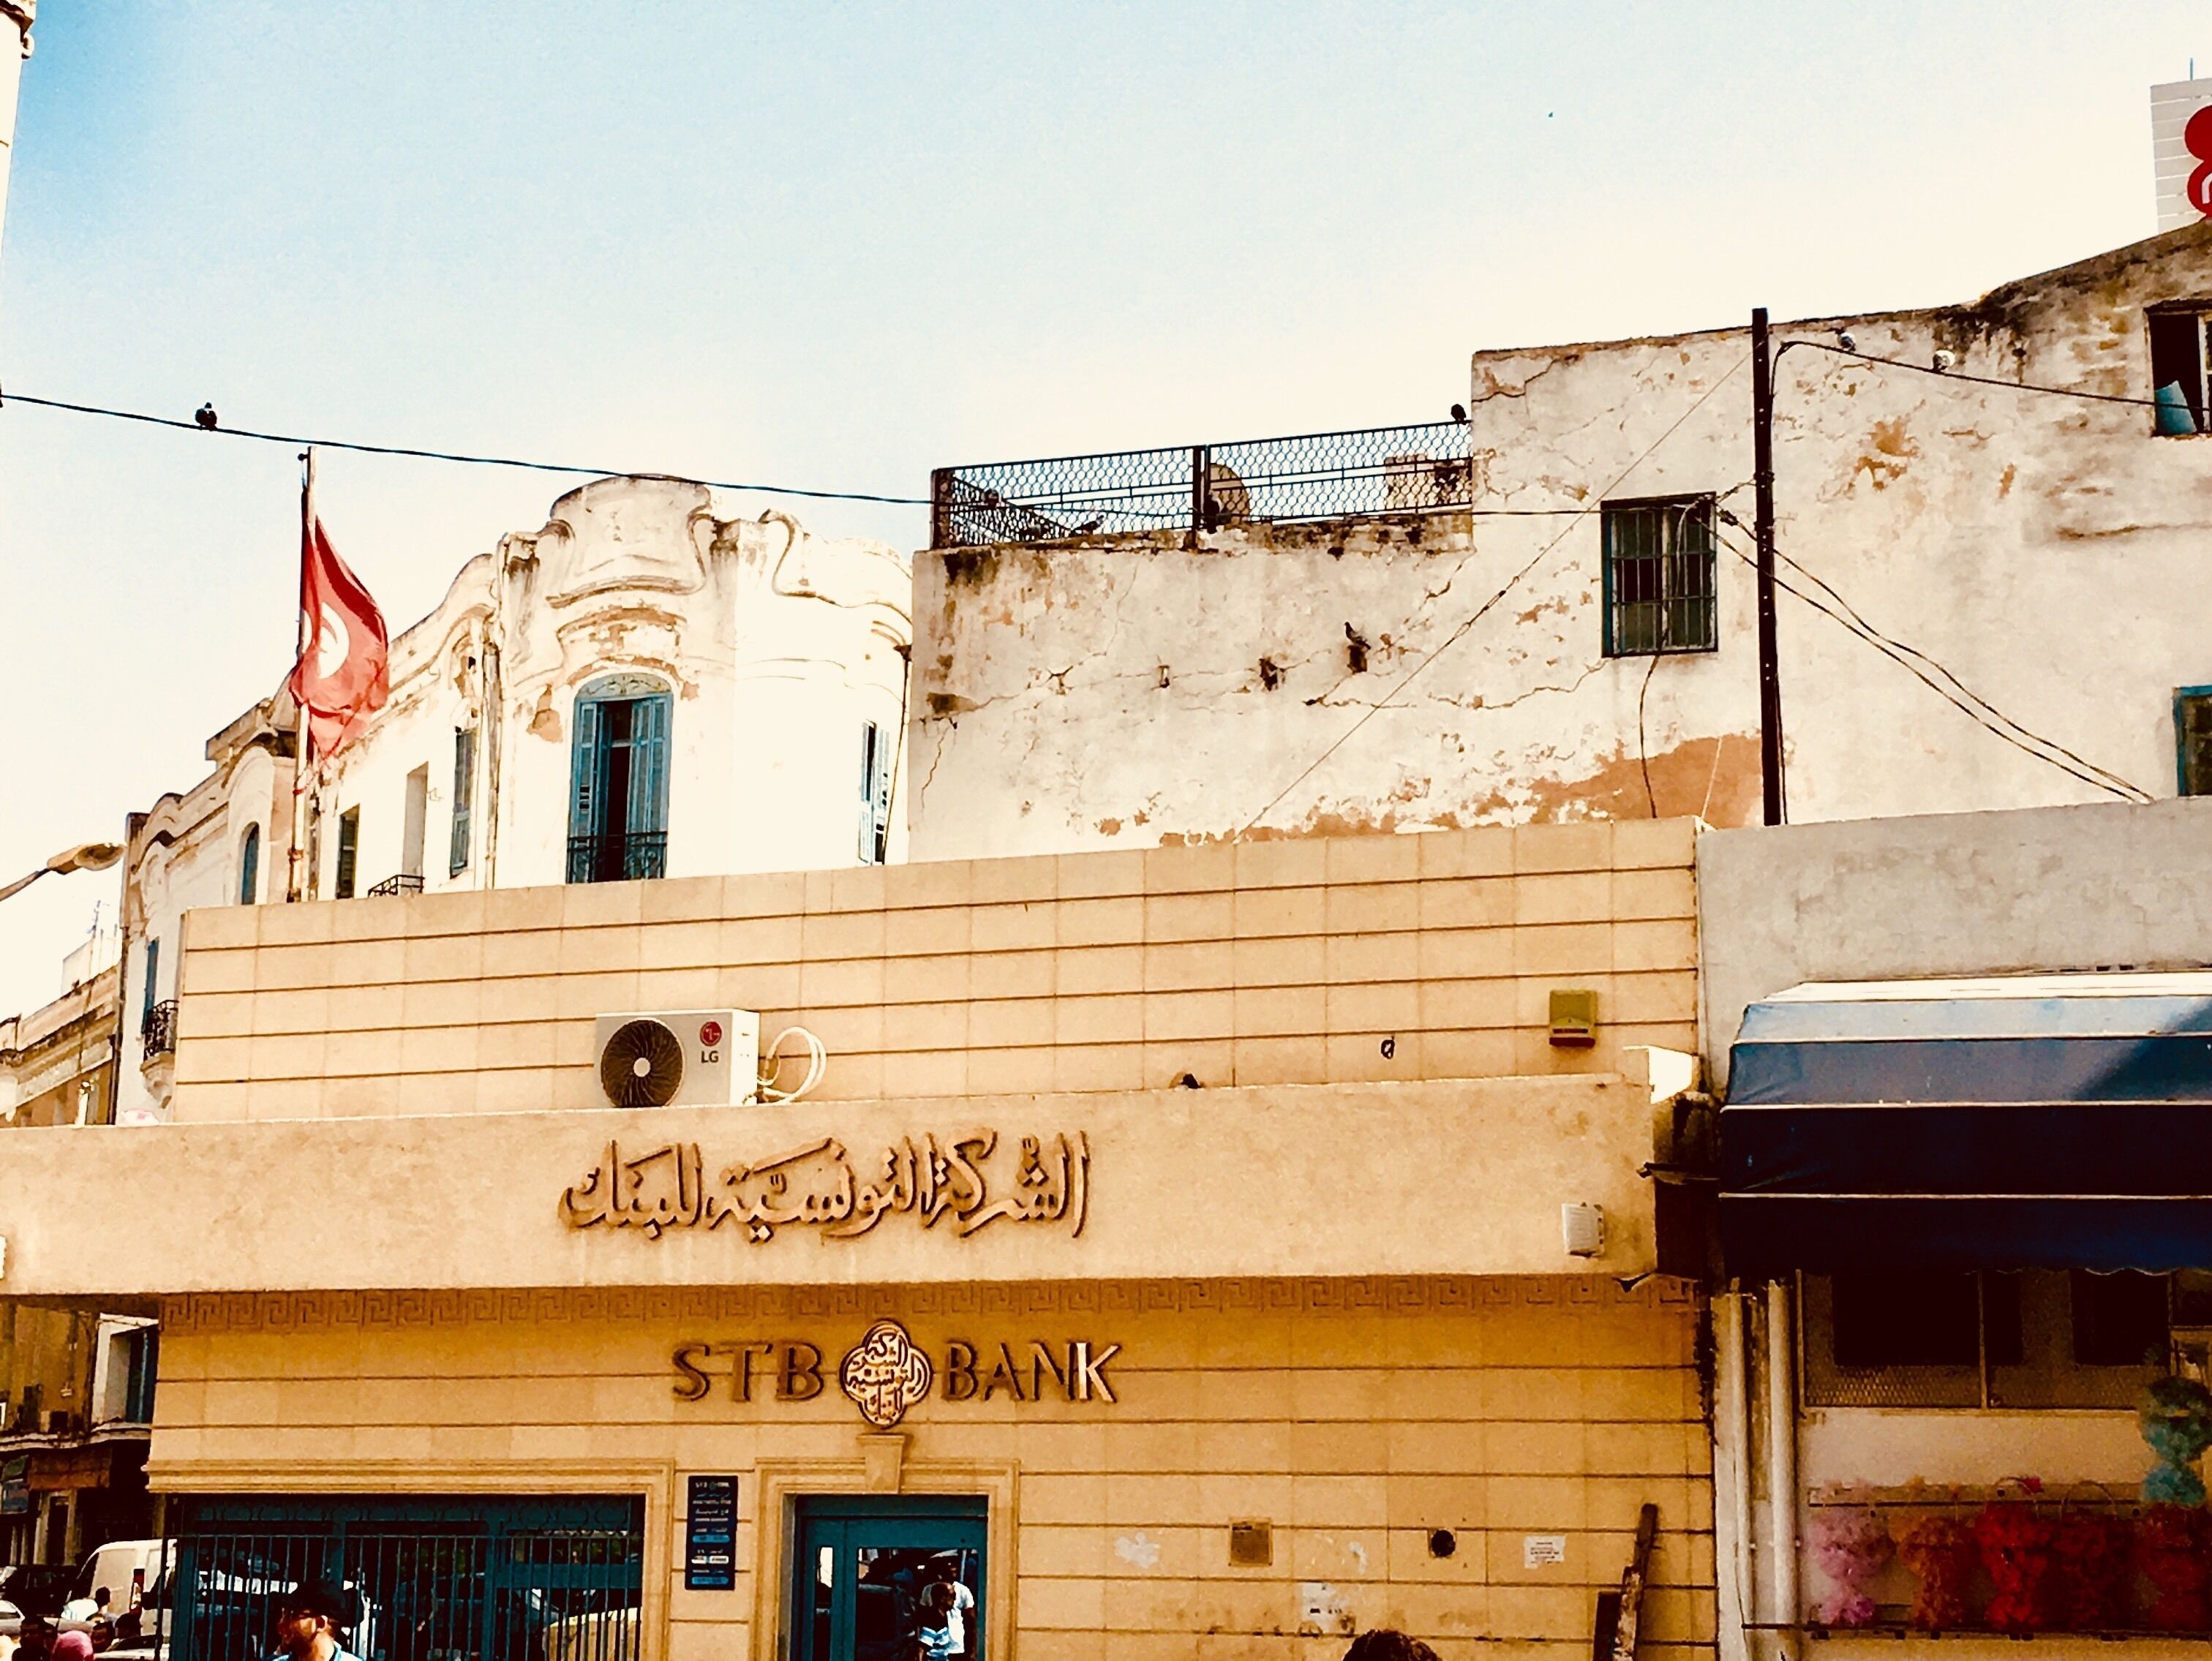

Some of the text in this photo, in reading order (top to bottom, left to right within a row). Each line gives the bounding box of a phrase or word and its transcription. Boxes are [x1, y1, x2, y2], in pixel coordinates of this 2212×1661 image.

[701, 1050, 719, 1063] LG
[672, 1341, 1120, 1403] STB BANK
